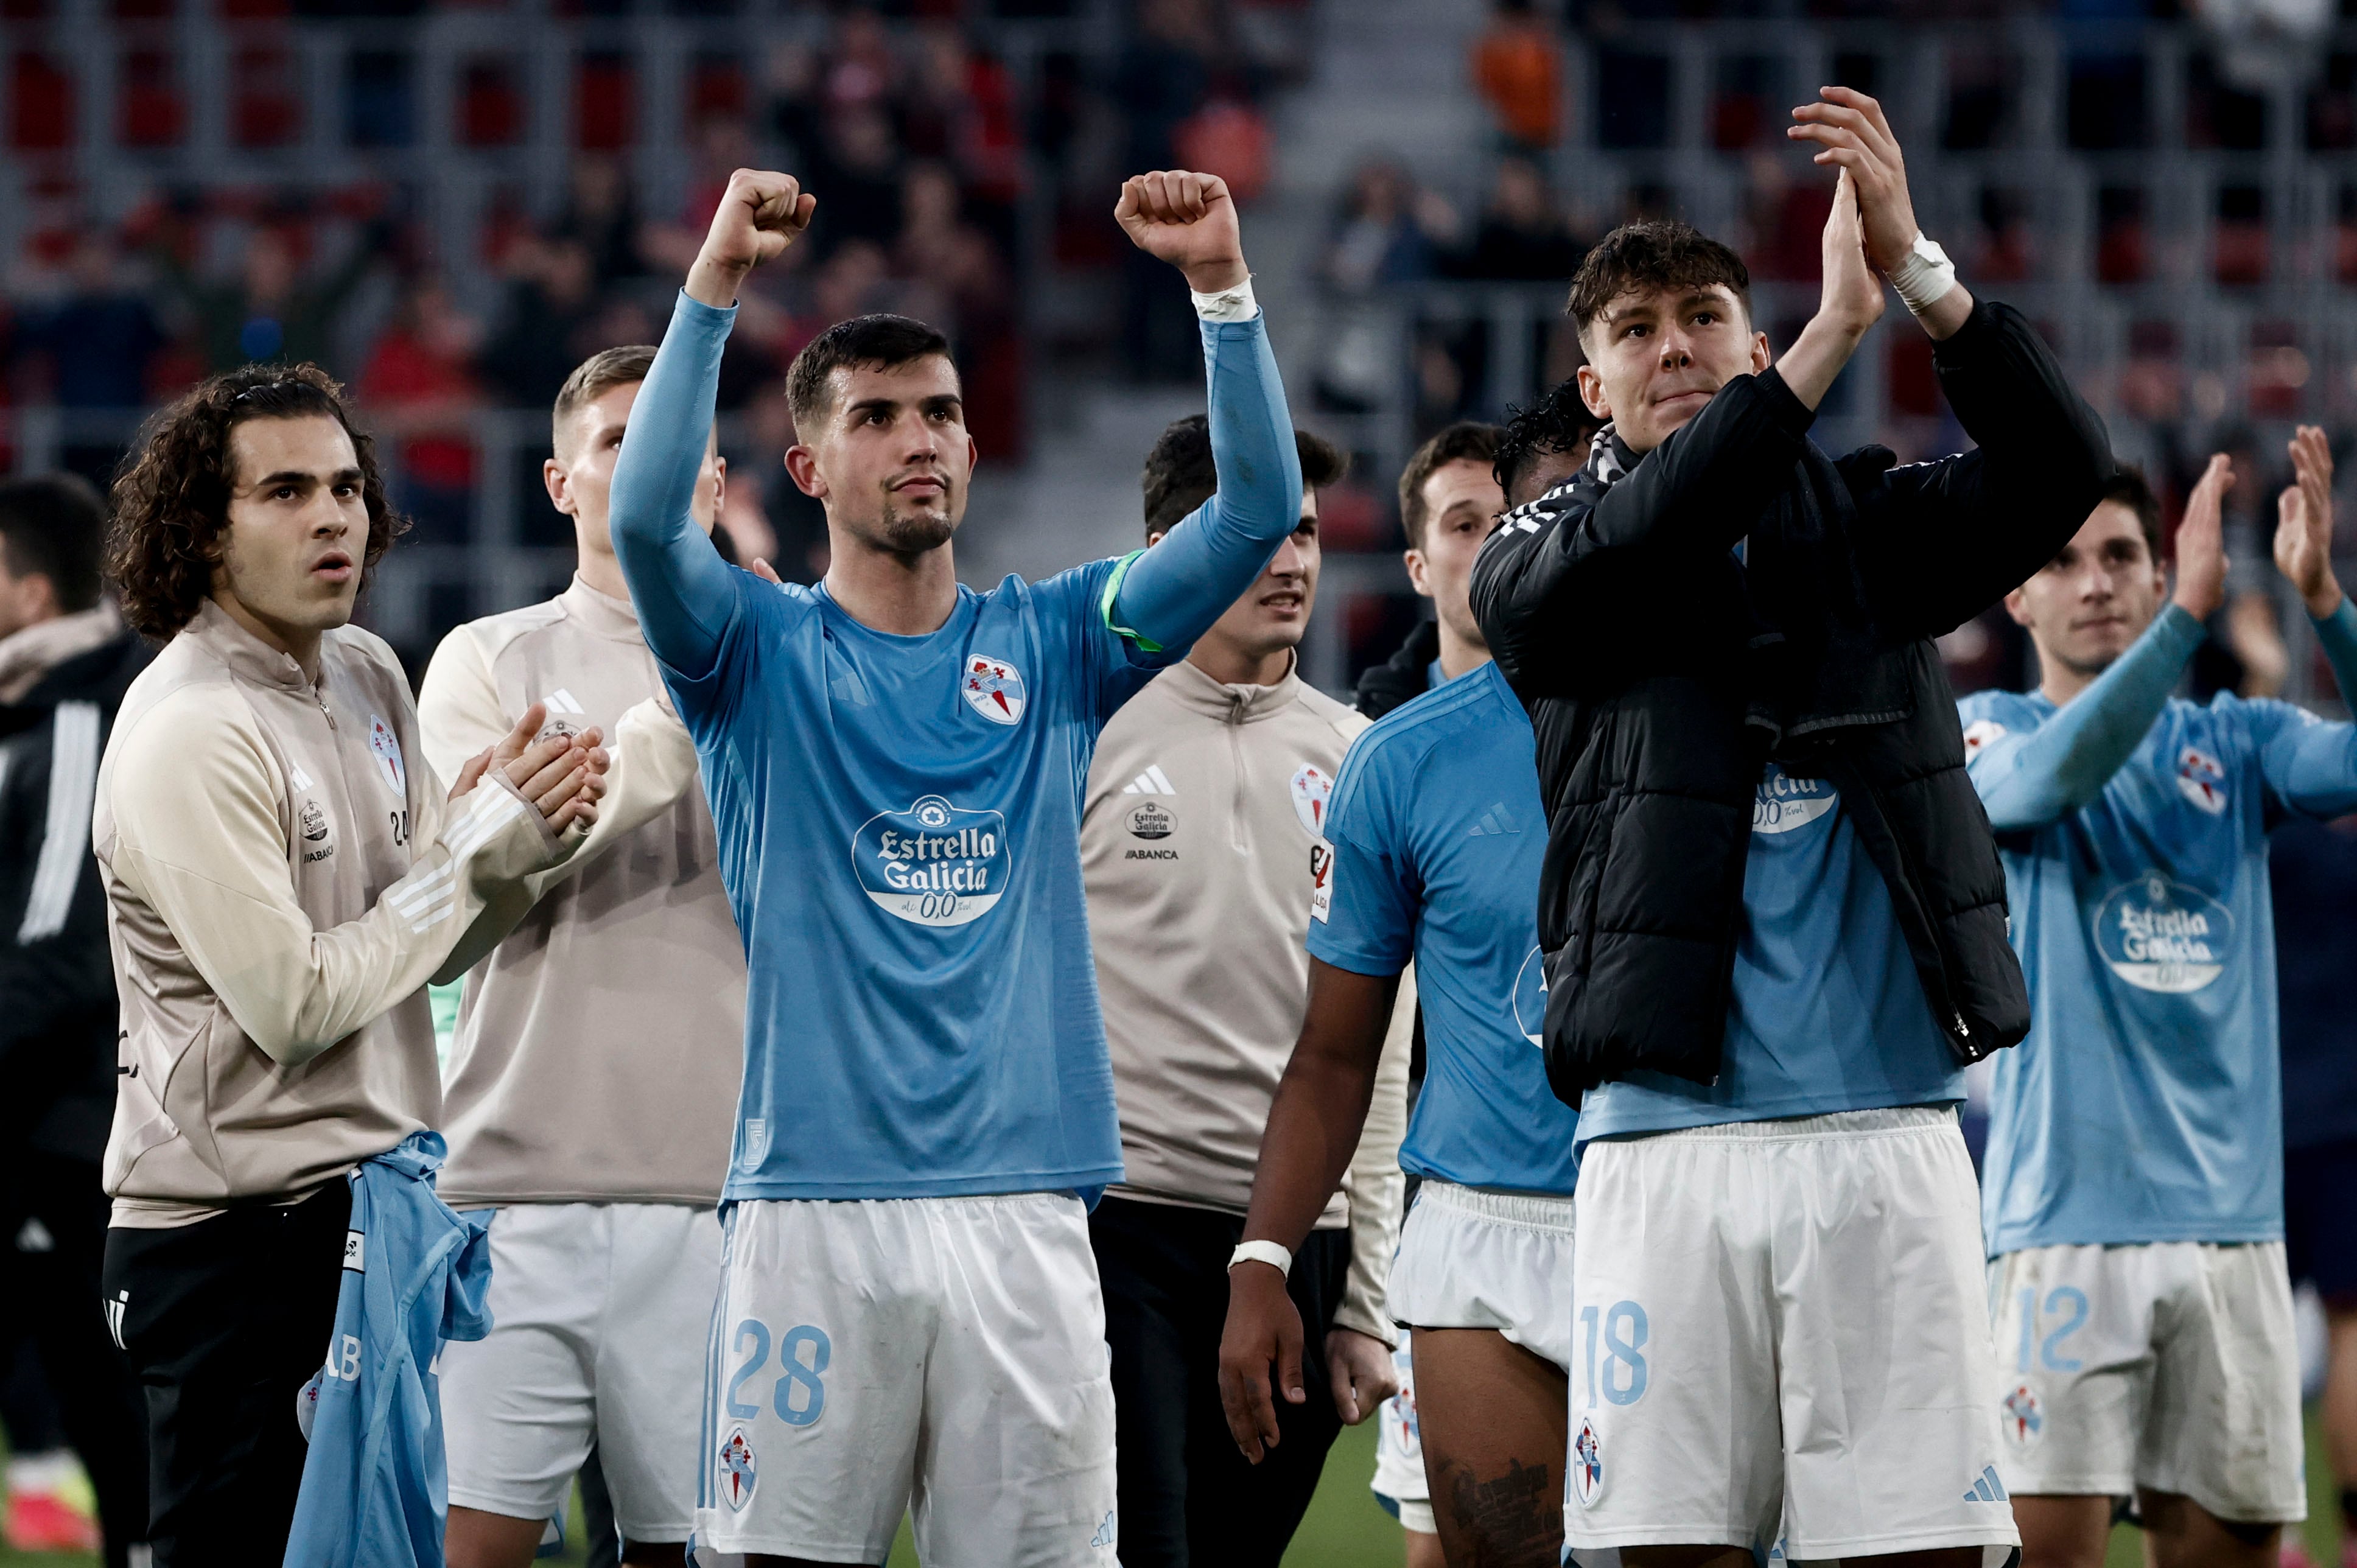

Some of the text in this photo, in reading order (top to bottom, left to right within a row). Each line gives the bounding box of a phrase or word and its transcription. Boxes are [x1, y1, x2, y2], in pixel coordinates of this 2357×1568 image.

[1135, 812, 1169, 822] Estrella
[1135, 821, 1168, 830] Galicia
[877, 827, 997, 861] Estrella
[883, 860, 987, 891] Galicia
[920, 892, 956, 919] 0,0
[2017, 1286, 2090, 1373] 12
[1580, 1300, 1648, 1409] 18
[726, 1318, 832, 1426] 28
